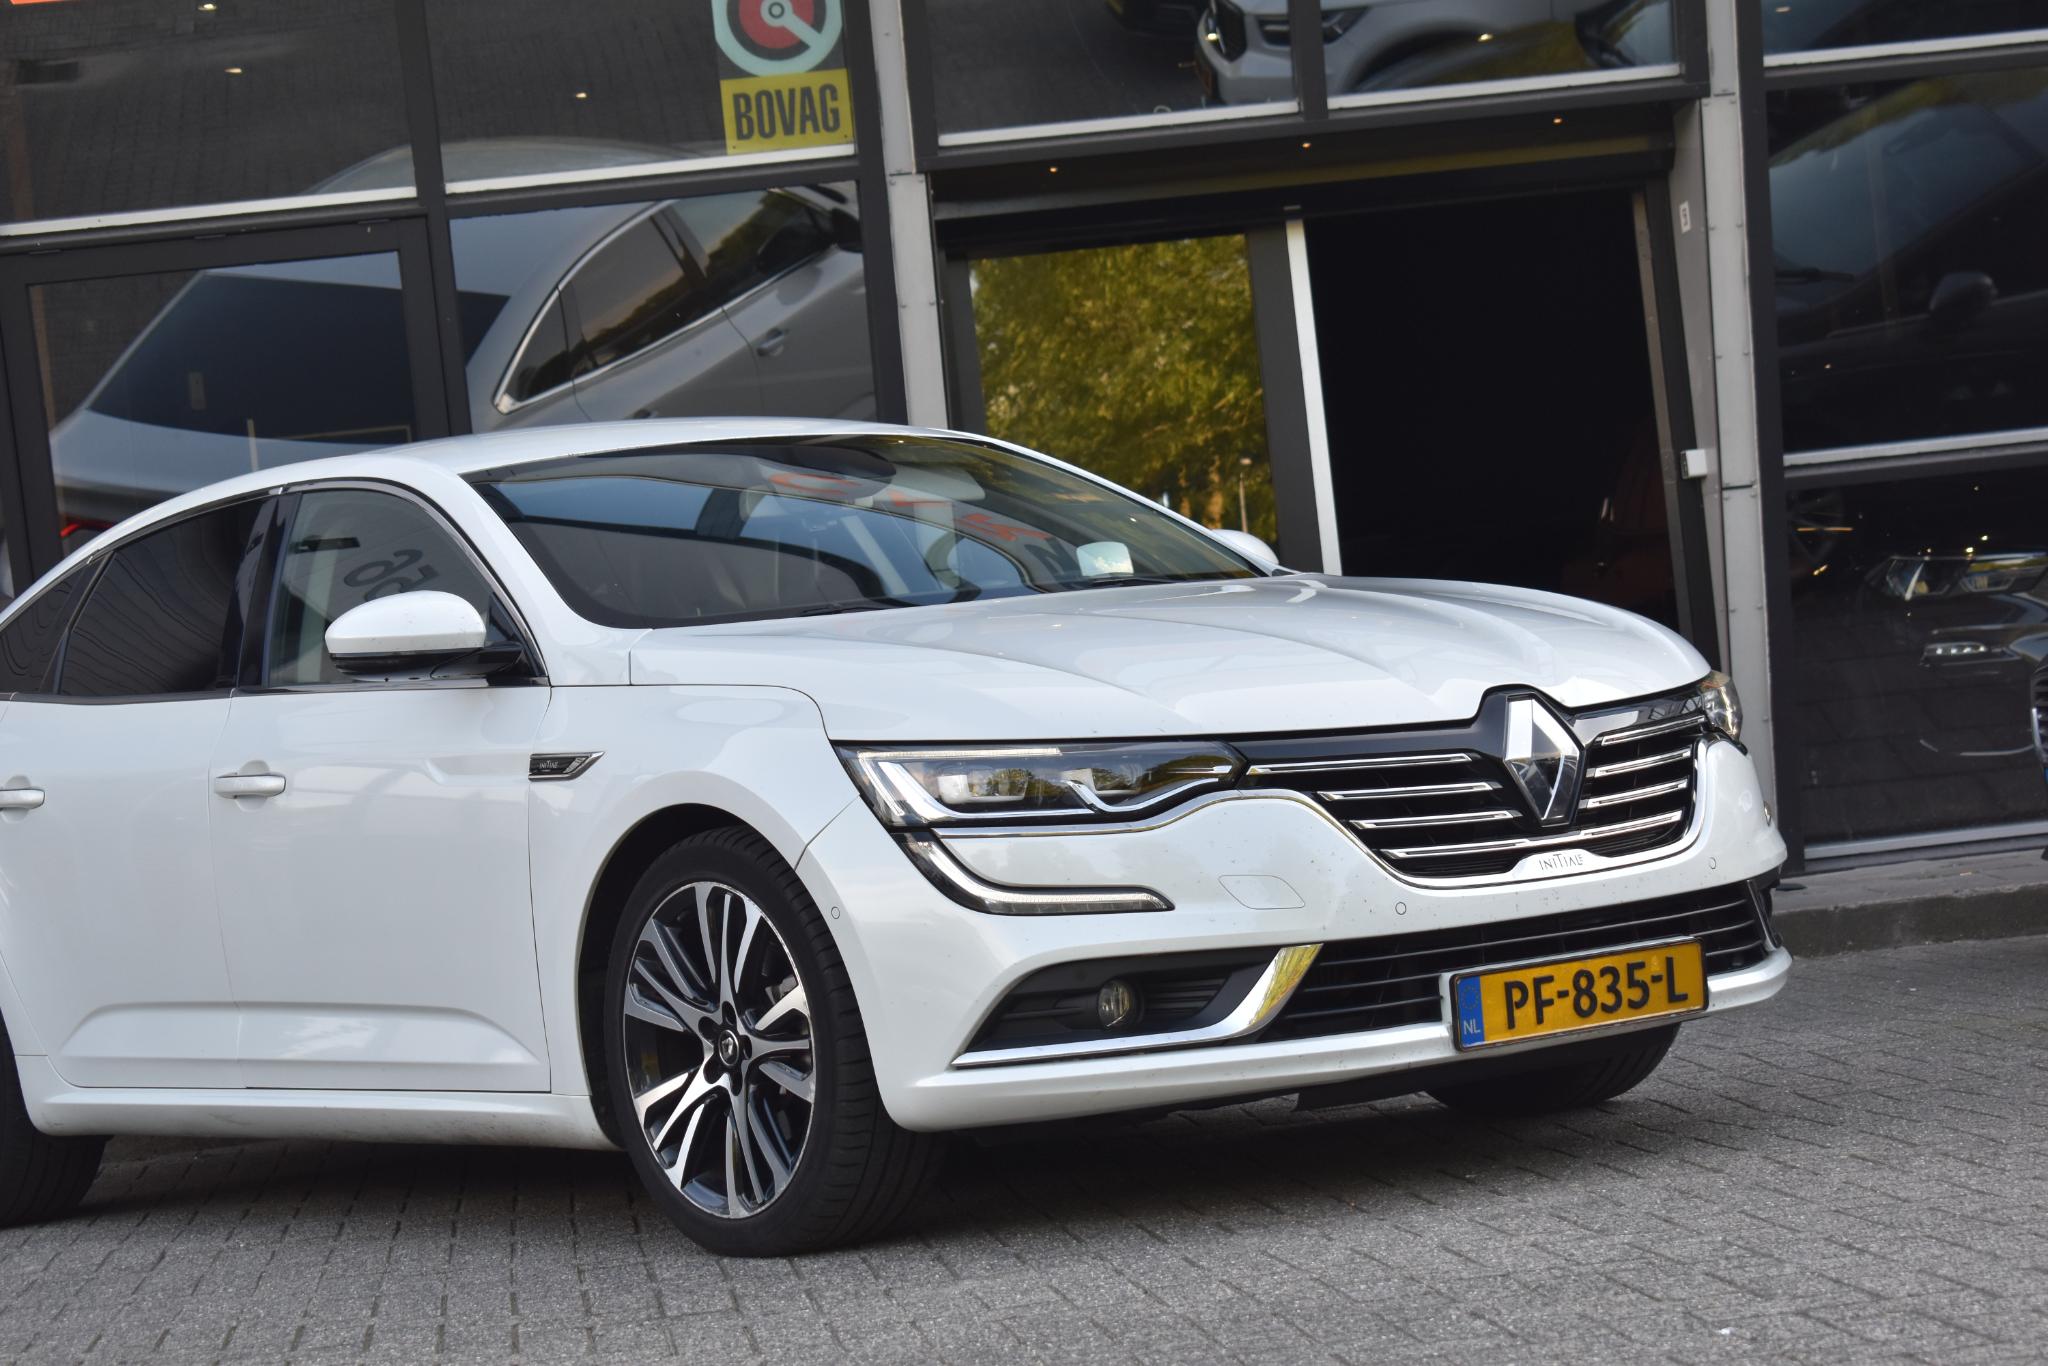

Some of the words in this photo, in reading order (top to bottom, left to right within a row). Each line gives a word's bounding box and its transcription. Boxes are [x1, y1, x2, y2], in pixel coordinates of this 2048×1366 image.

[732, 83, 841, 141] BOVAG
[1503, 956, 1689, 1031] PF-835-L
[1462, 1019, 1482, 1036] NL
